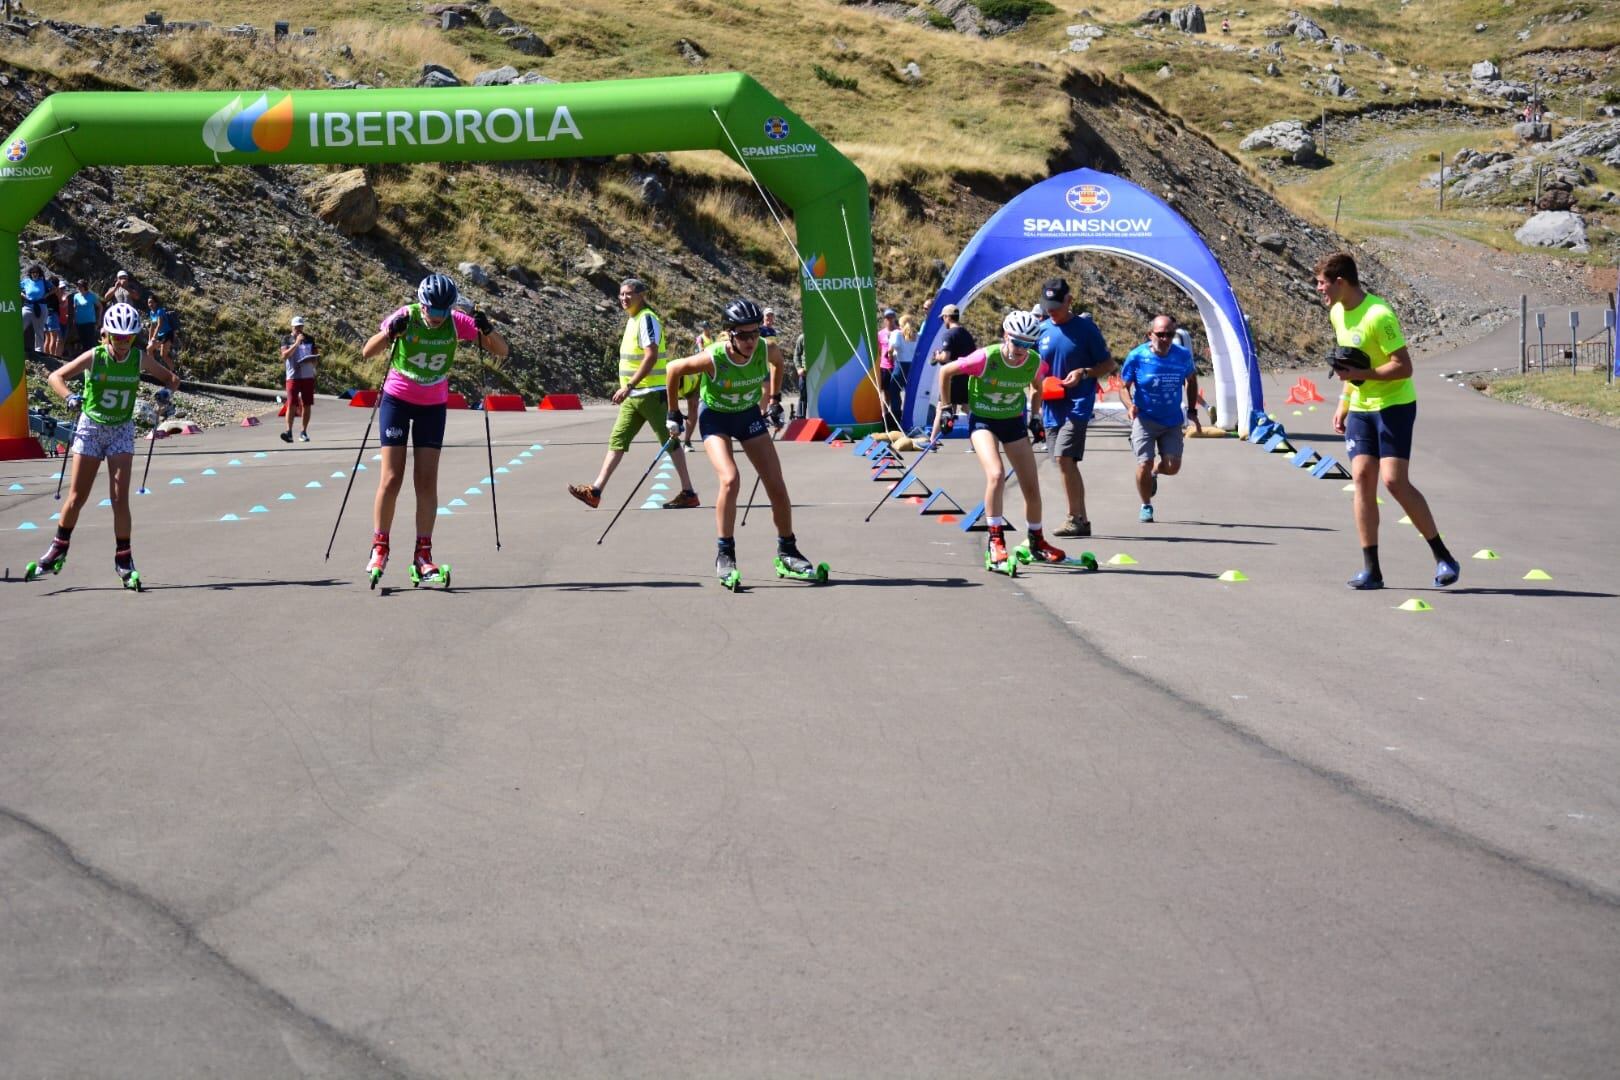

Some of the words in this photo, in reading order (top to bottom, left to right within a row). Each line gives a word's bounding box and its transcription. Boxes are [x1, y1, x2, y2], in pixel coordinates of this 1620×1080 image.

[309, 105, 583, 147] IBERDROLA
[741, 143, 816, 156] SPAINSNOW
[1023, 217, 1152, 232] SPAINSNOW
[803, 275, 873, 291] IBERDROLA
[0, 300, 16, 313] LA
[407, 352, 448, 371] 48
[100, 389, 130, 410] 51
